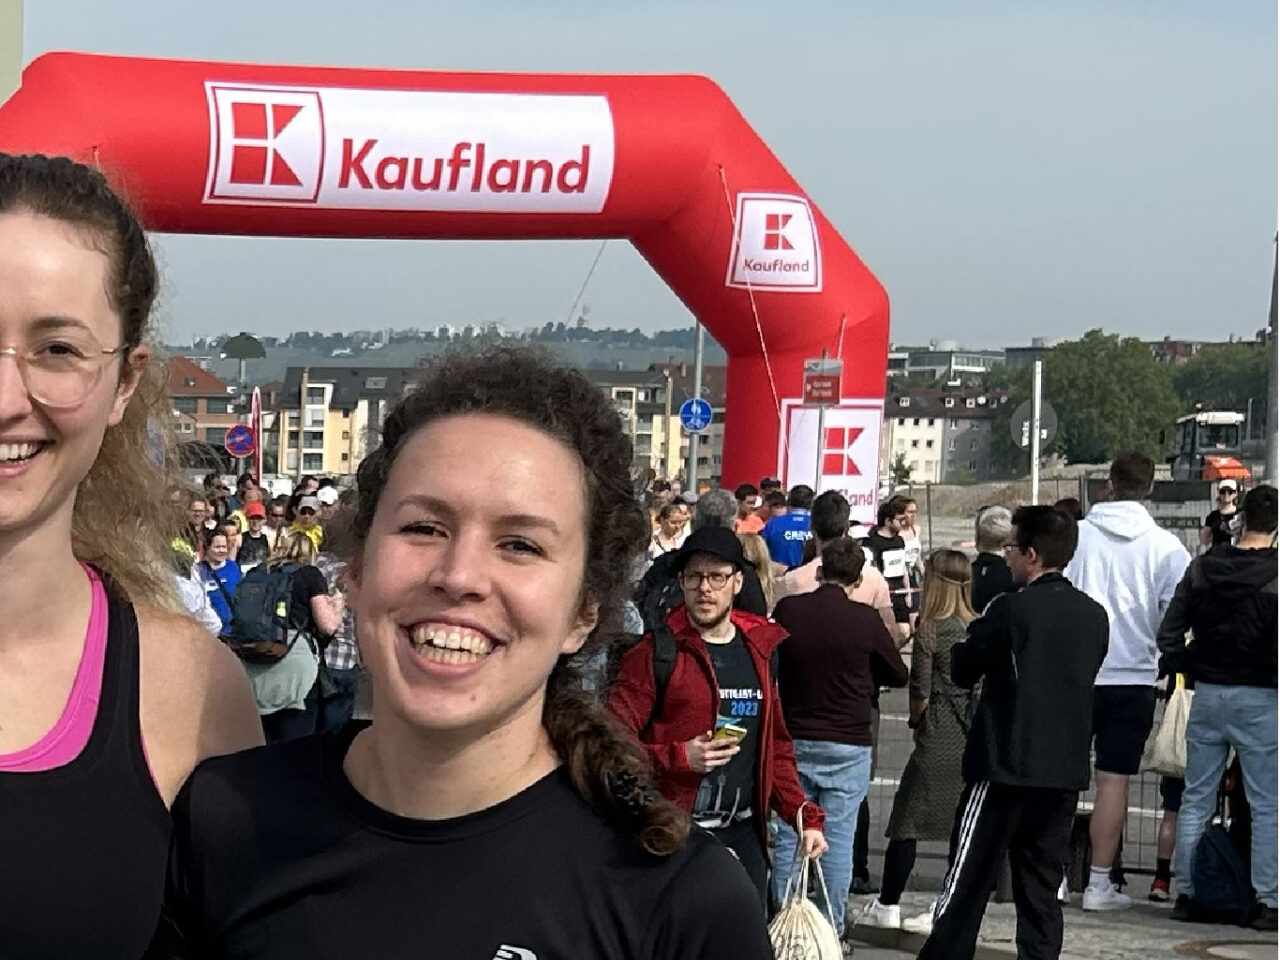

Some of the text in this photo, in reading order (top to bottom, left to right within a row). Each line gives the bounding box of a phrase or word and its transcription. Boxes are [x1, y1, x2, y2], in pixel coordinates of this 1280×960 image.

[337, 138, 592, 194] Kaufland
[742, 258, 810, 273] Kaufland
[730, 700, 759, 717] 2023
